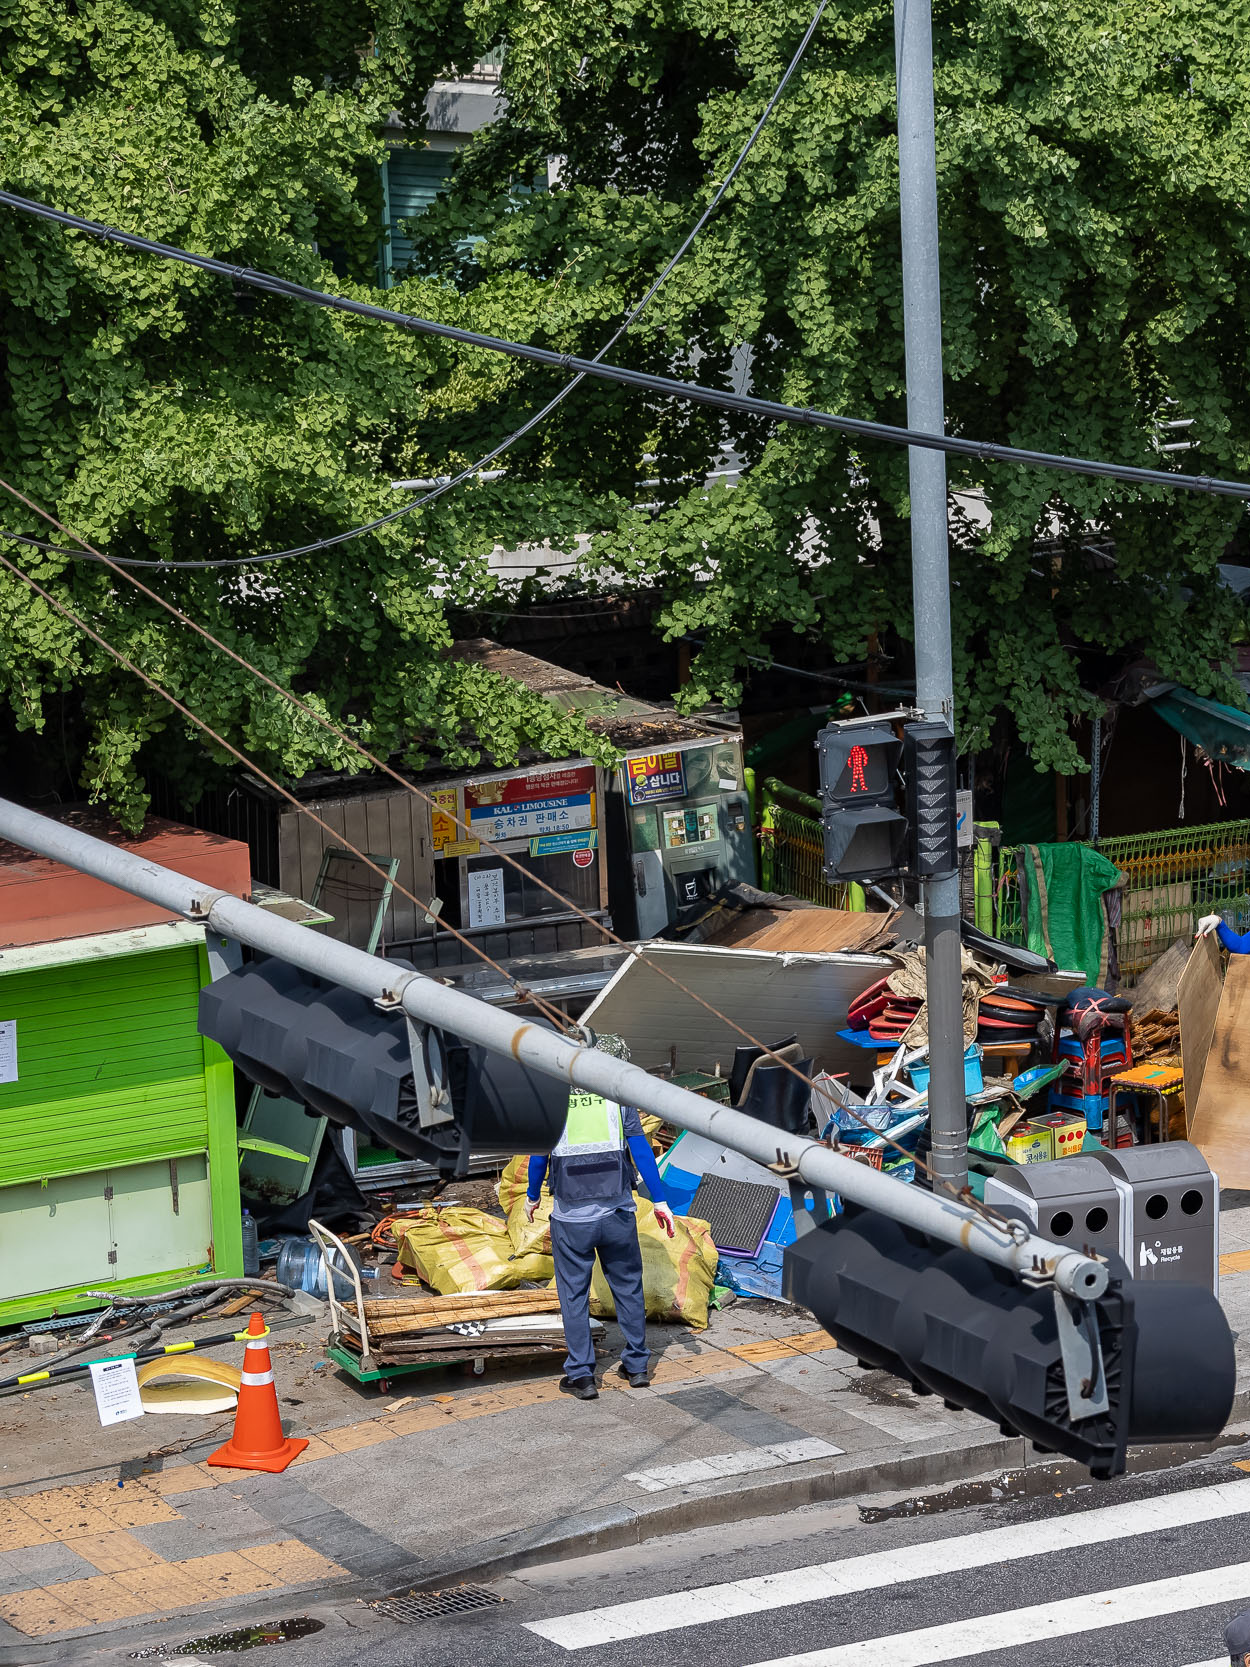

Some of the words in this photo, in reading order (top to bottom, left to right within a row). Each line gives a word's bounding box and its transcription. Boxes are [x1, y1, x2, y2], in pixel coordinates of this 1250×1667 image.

[631, 752, 677, 774] 금이빨
[650, 772, 680, 787] 삽니다
[493, 806, 512, 815] KAL
[521, 799, 568, 811] LIMOUSINE
[494, 814, 528, 830] 승차권
[535, 810, 569, 825] 판매소
[553, 823, 570, 831] 18:50
[1160, 1255, 1181, 1263] Recycle
